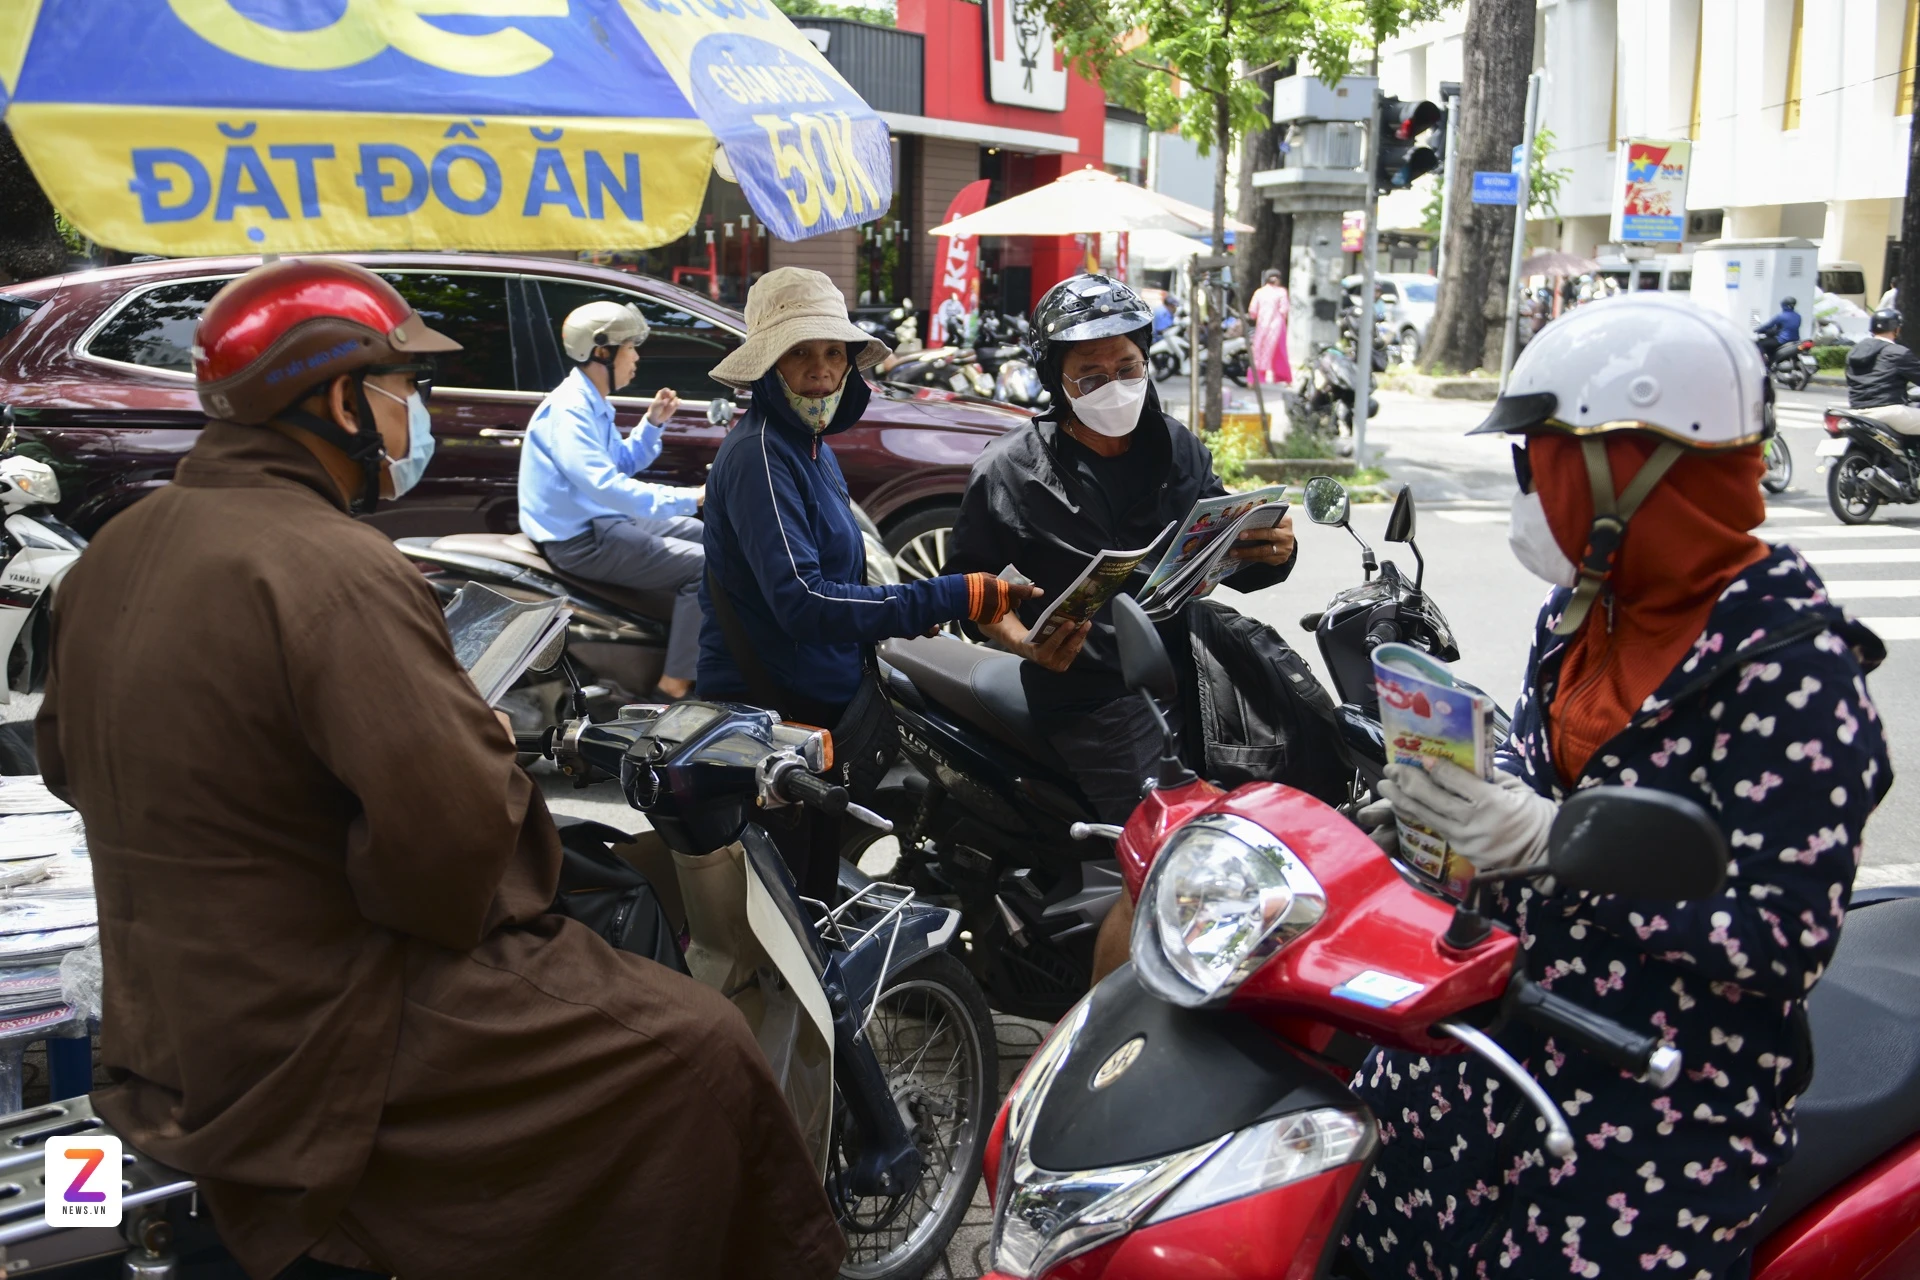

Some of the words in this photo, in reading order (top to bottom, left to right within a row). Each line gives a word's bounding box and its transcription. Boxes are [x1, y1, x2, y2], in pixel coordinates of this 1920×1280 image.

[708, 50, 787, 105] GIẢM
[778, 49, 835, 103] ĐẾN
[128, 121, 335, 243] ĐẶT
[354, 118, 502, 217] ĐỒ
[522, 127, 644, 222] ĂN
[752, 111, 880, 227] 50K
[9, 573, 41, 585] YAMAHA
